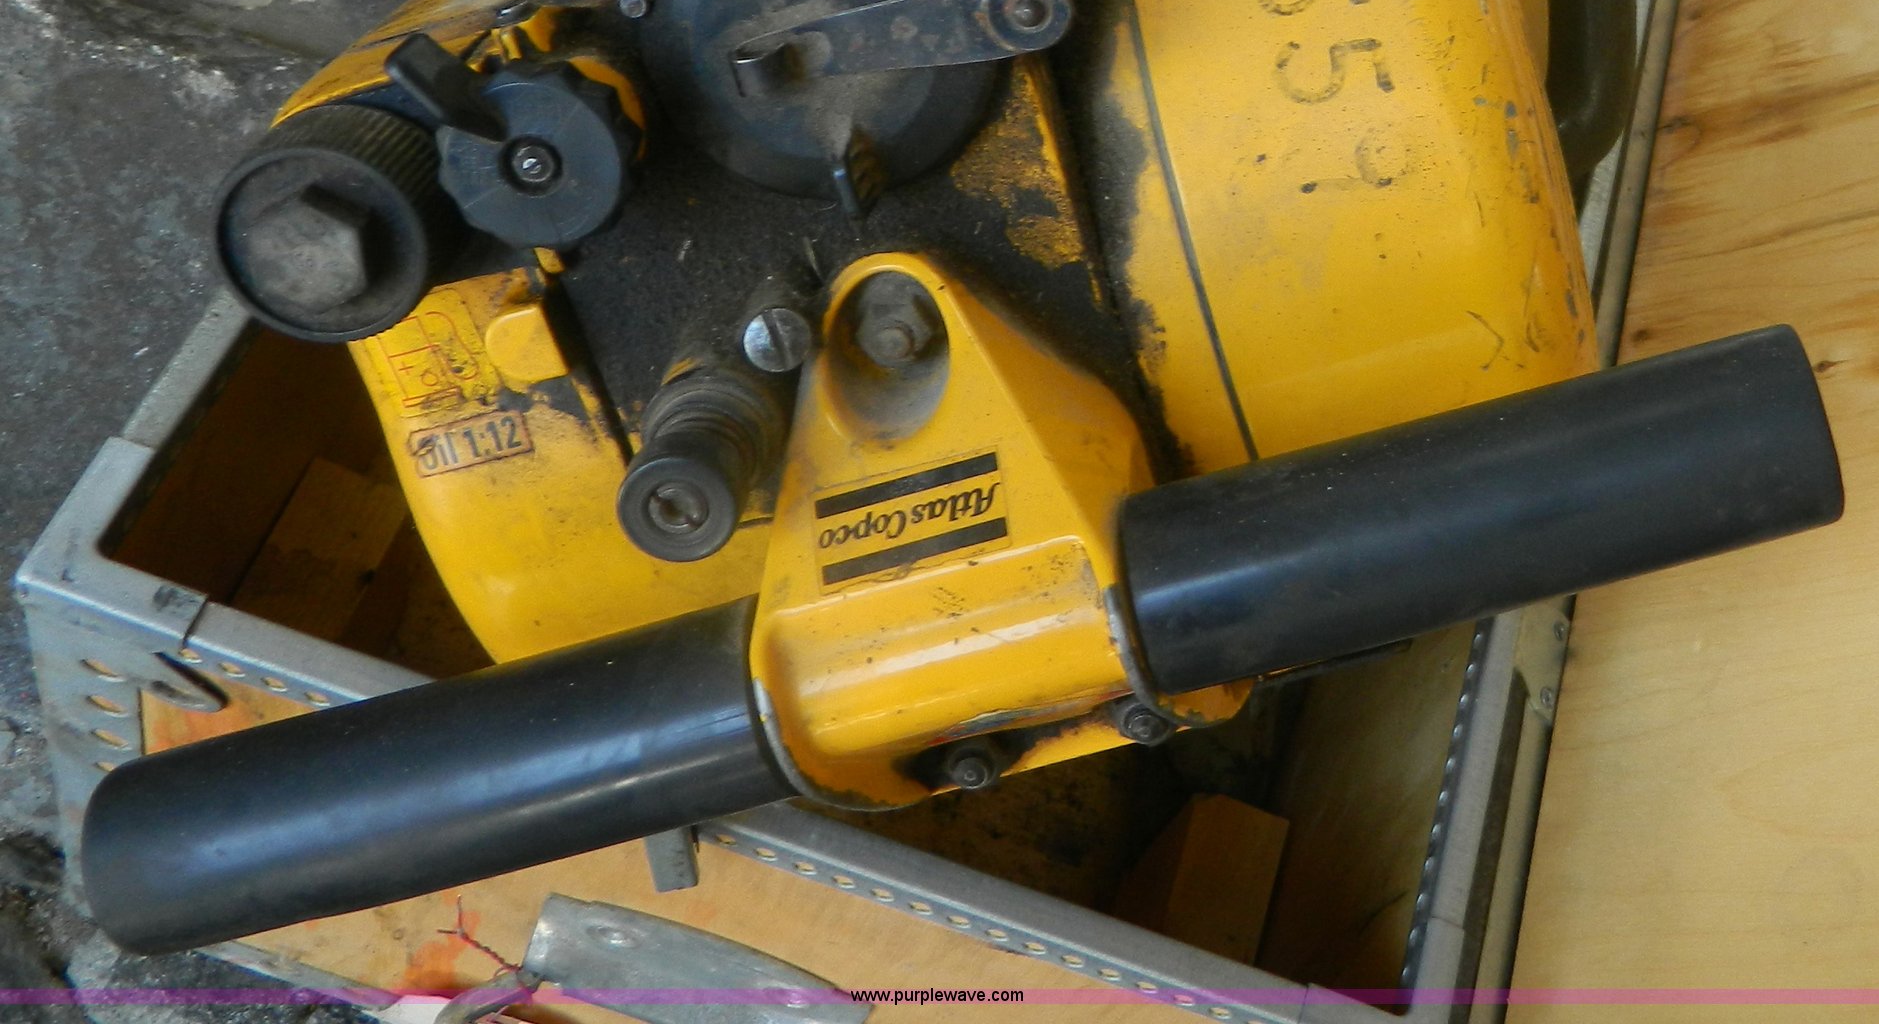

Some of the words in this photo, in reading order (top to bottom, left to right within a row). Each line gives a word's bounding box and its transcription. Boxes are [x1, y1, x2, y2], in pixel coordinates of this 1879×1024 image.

[462, 416, 521, 457] 1:12
[910, 483, 1000, 525] Atlas
[818, 510, 907, 549] Copco
